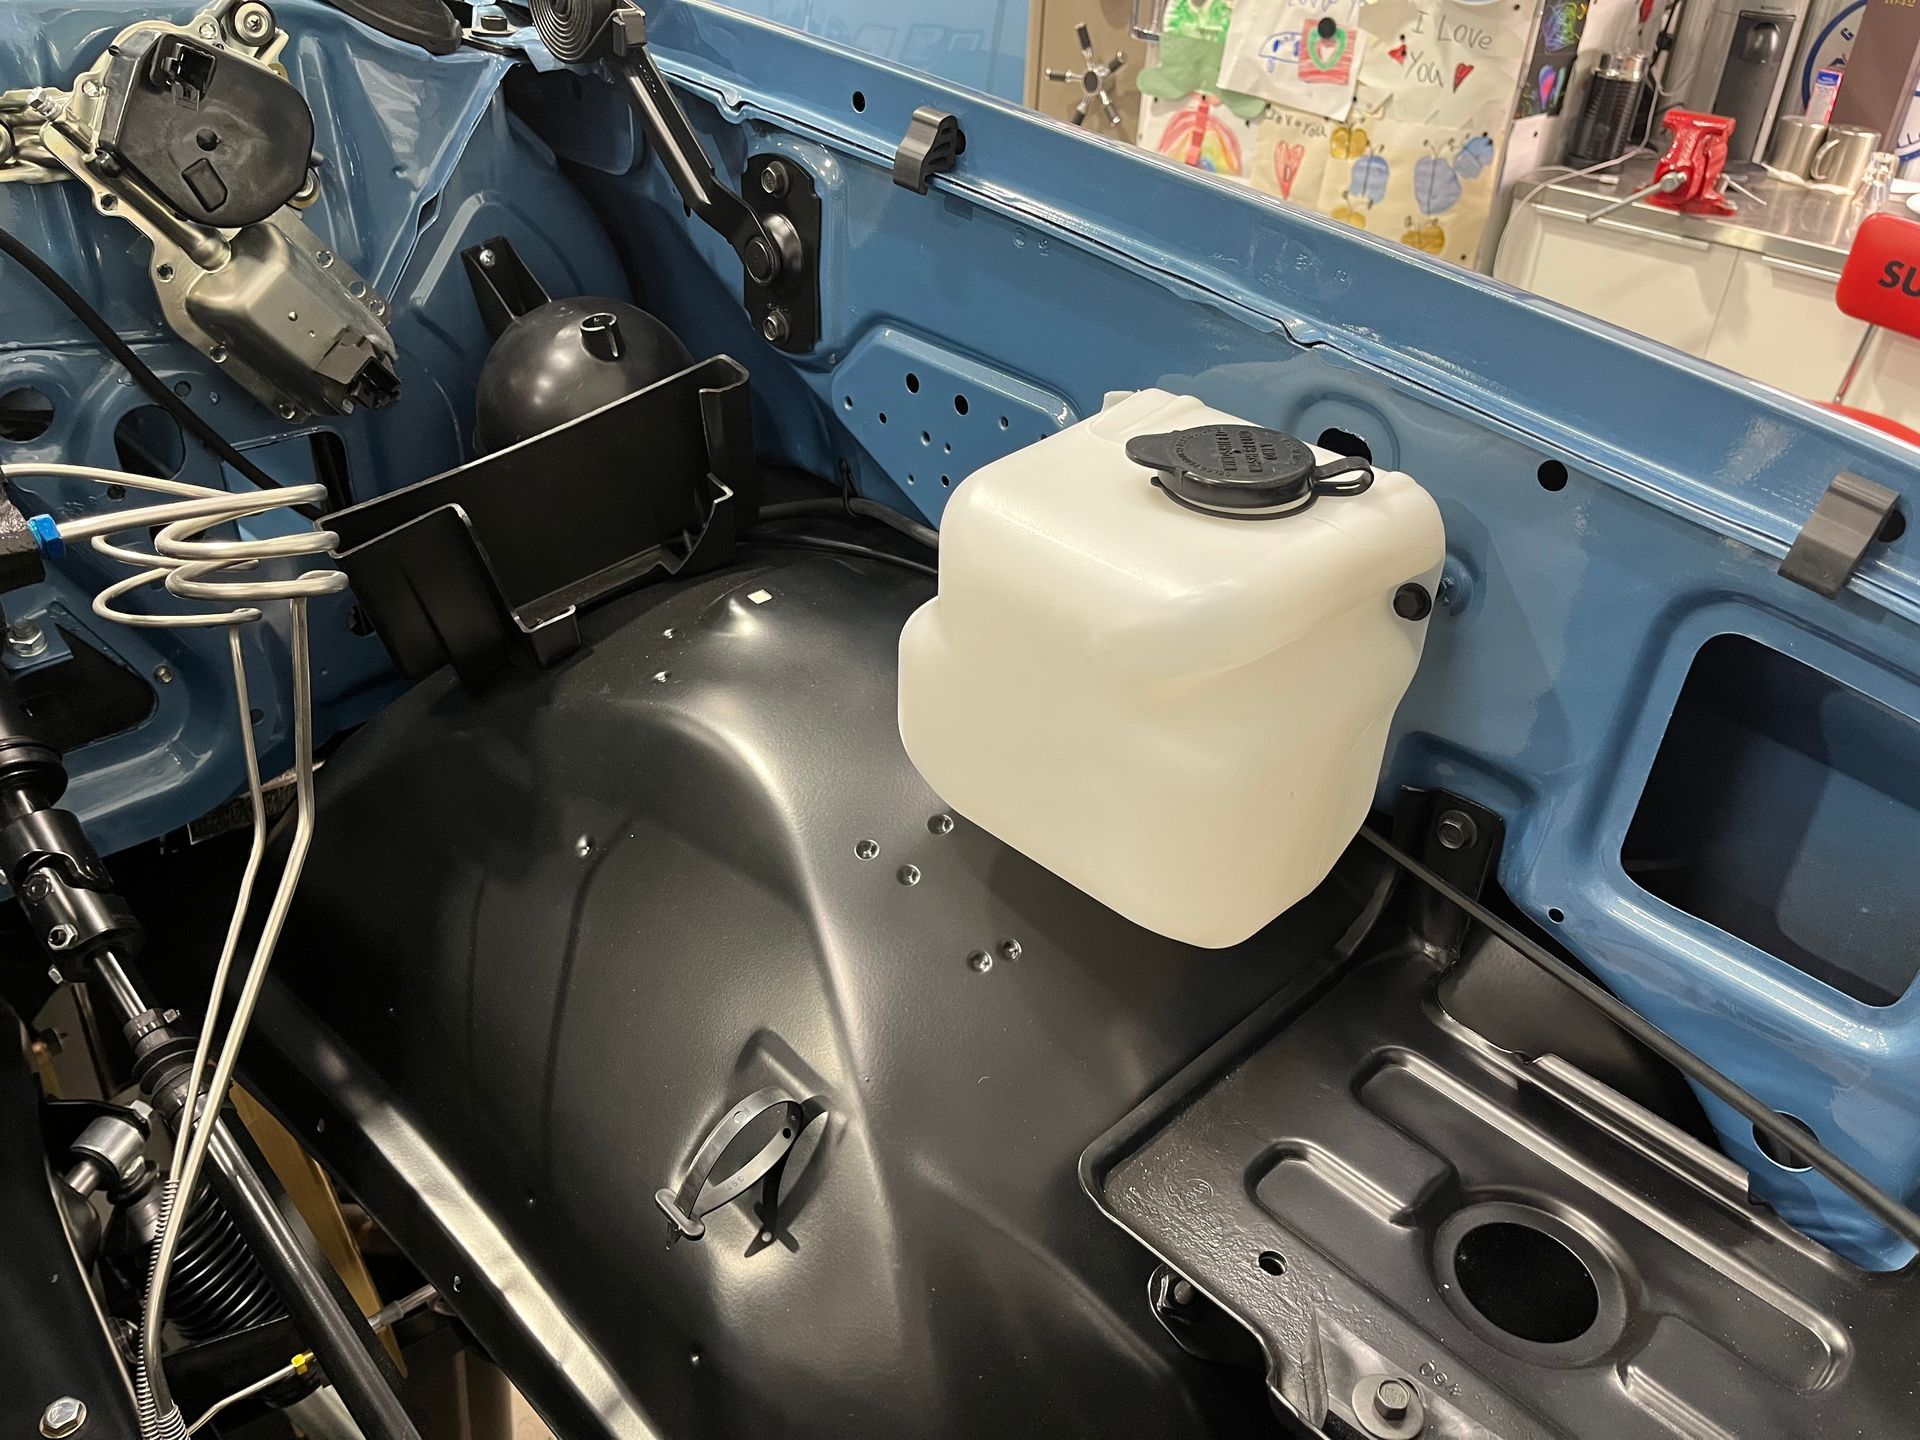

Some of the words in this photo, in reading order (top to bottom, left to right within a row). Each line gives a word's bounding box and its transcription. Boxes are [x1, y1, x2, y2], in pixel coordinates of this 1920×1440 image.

[1411, 9, 1429, 35] I
[1437, 14, 1493, 50] Love
[1404, 51, 1443, 88] You
